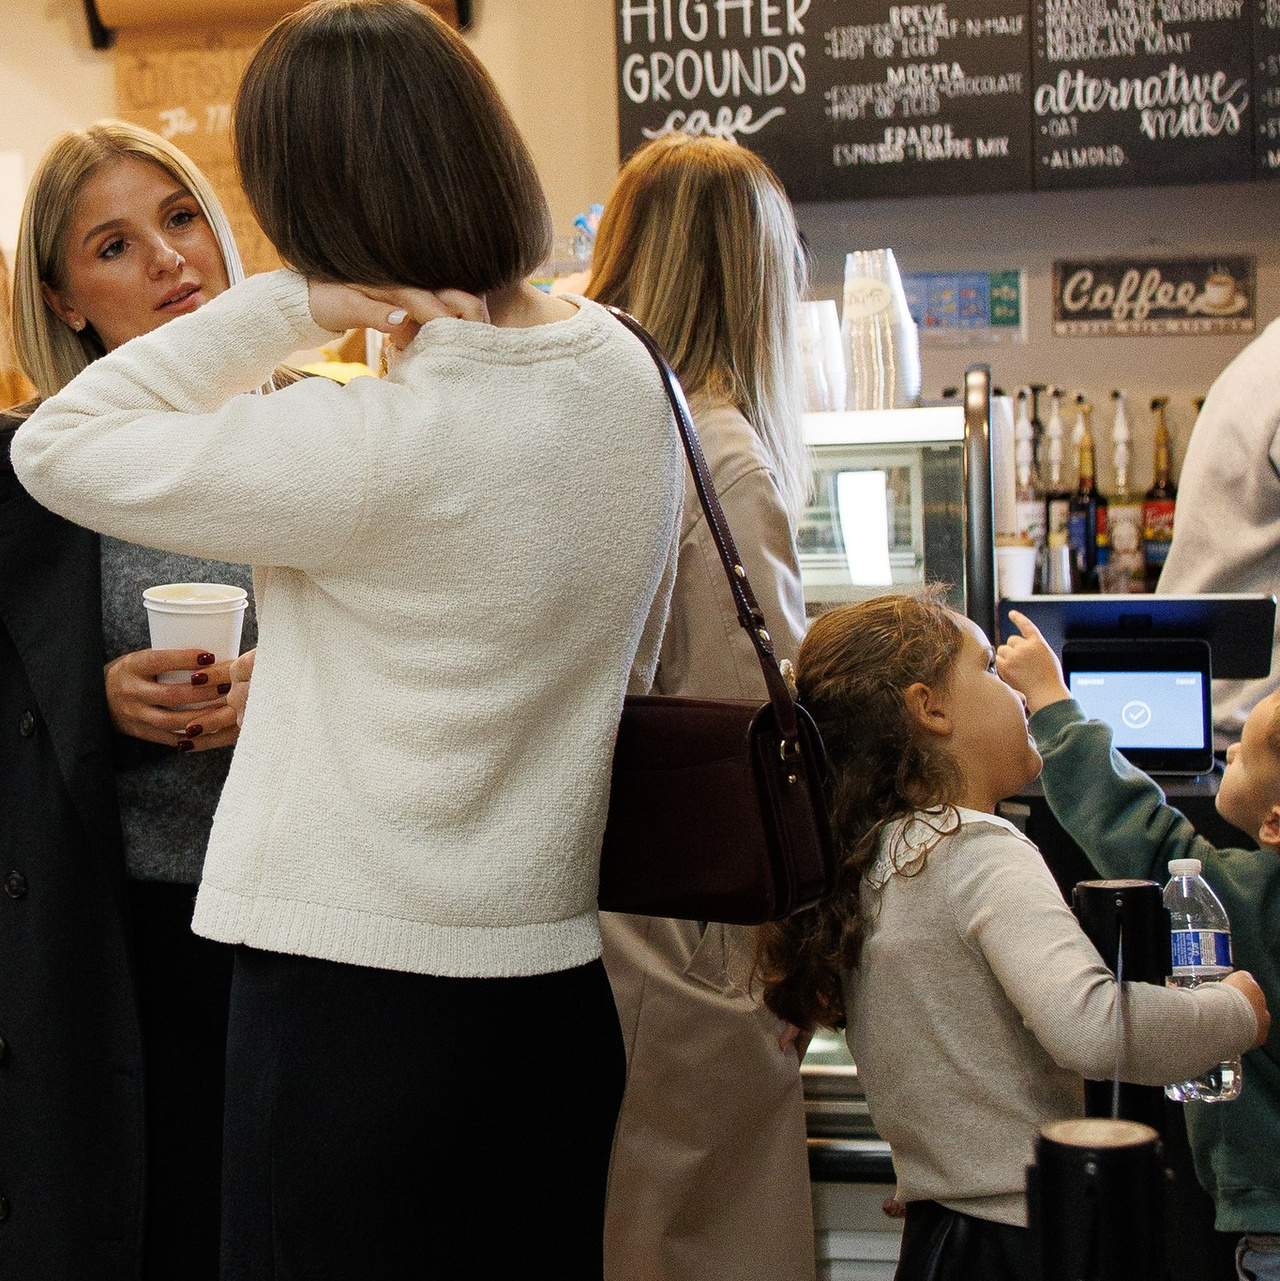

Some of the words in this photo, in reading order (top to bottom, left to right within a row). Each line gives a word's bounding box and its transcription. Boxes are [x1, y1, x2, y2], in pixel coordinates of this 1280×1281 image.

[623, 42, 806, 104] GROUNDS
[886, 62, 965, 85] MOCHA
[1034, 62, 1247, 116] alternative
[1048, 116, 1079, 137] OAT
[1140, 92, 1250, 140] milks
[1050, 144, 1125, 169] ALMOND
[1063, 267, 1196, 320] Coffee
